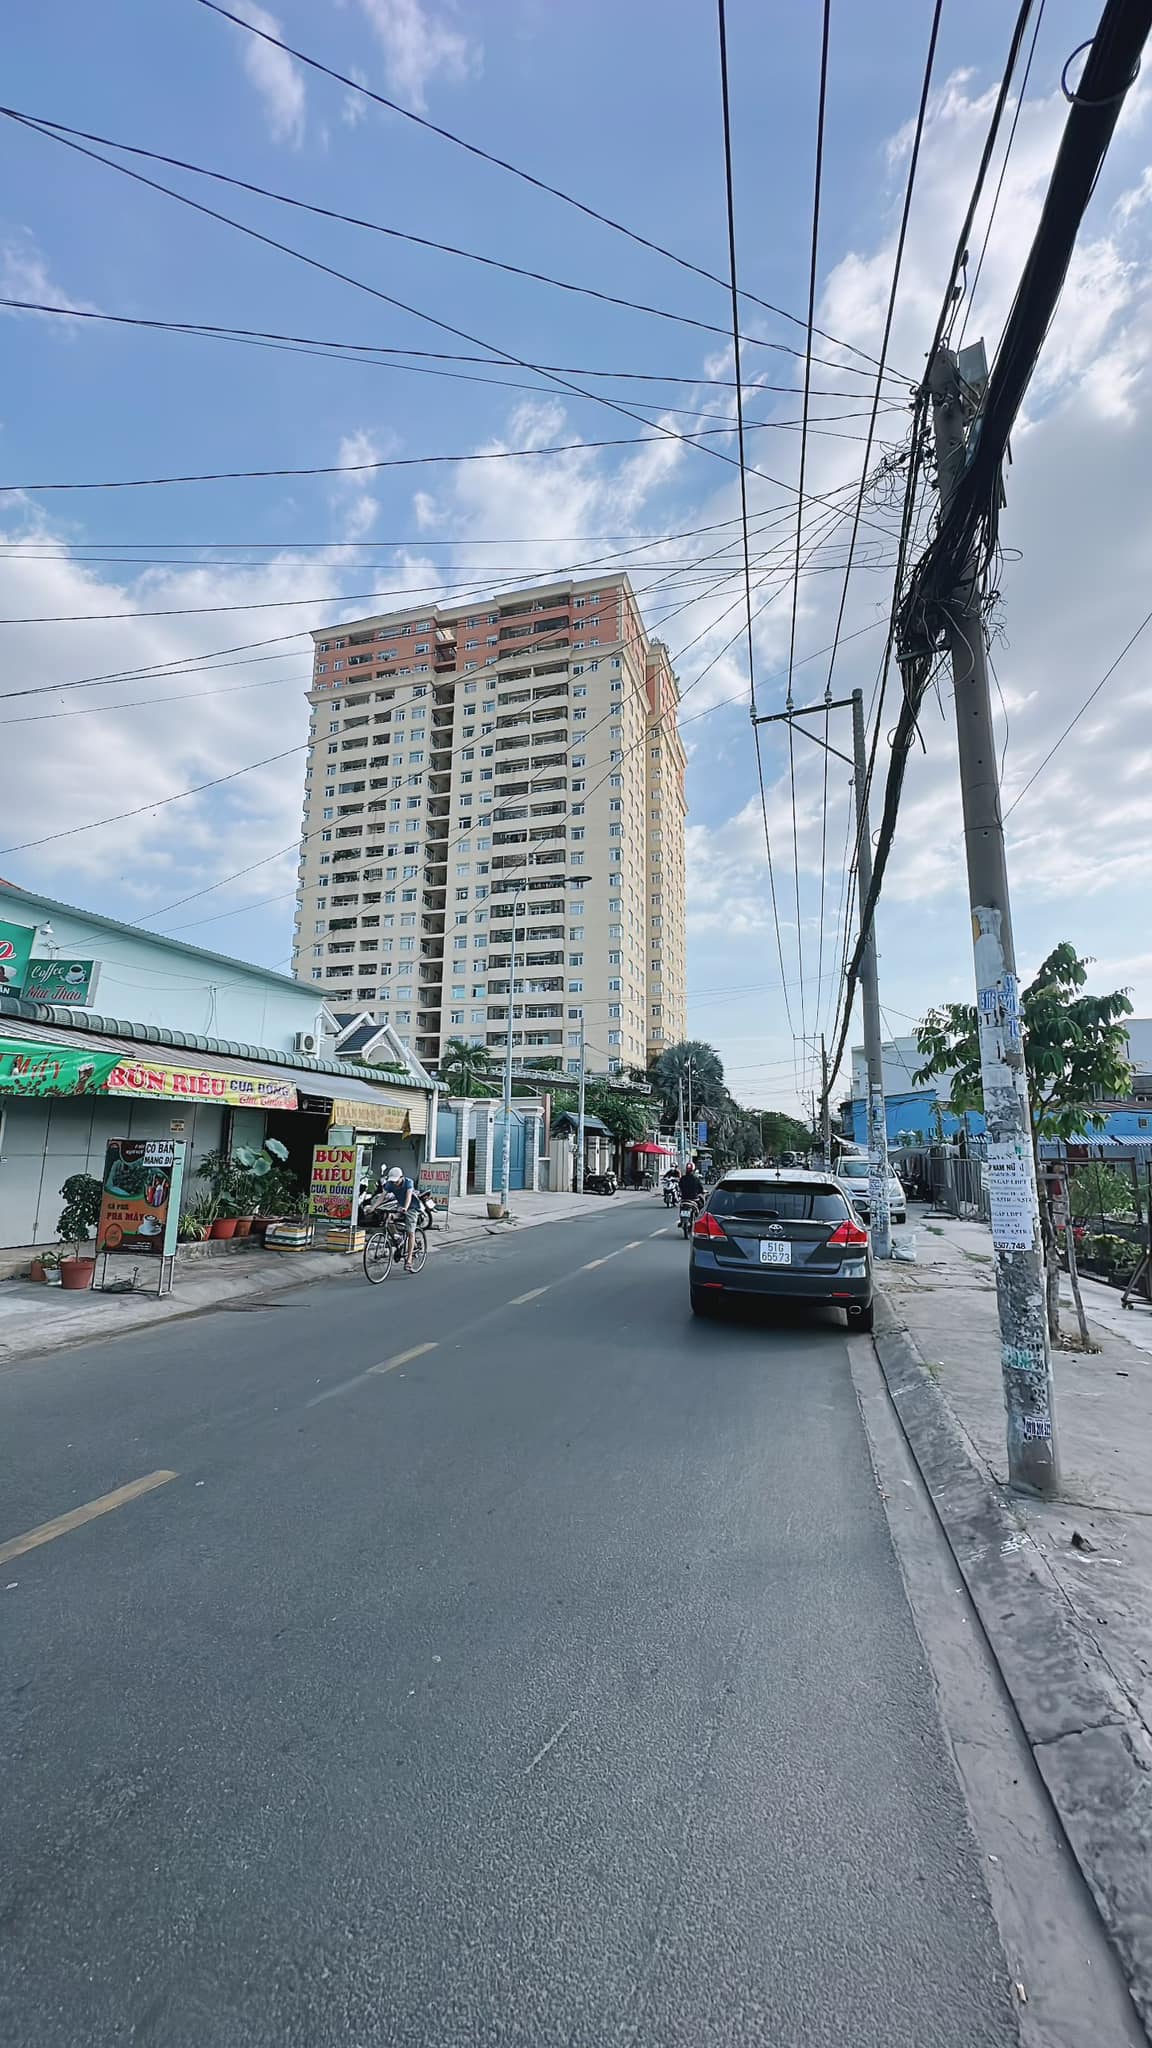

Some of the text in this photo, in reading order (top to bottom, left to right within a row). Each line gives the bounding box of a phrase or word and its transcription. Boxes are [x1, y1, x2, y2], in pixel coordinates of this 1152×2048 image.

[31, 962, 65, 983] Coffee
[108, 1064, 167, 1091] BÚN
[172, 1072, 226, 1096] RIÊU
[230, 1080, 254, 1093] CUA
[315, 1146, 355, 1163] BÚN
[312, 1165, 352, 1182] RIÊU
[311, 1184, 327, 1194] CUA
[767, 1242, 784, 1253] 51G
[761, 1251, 790, 1263] 65573
